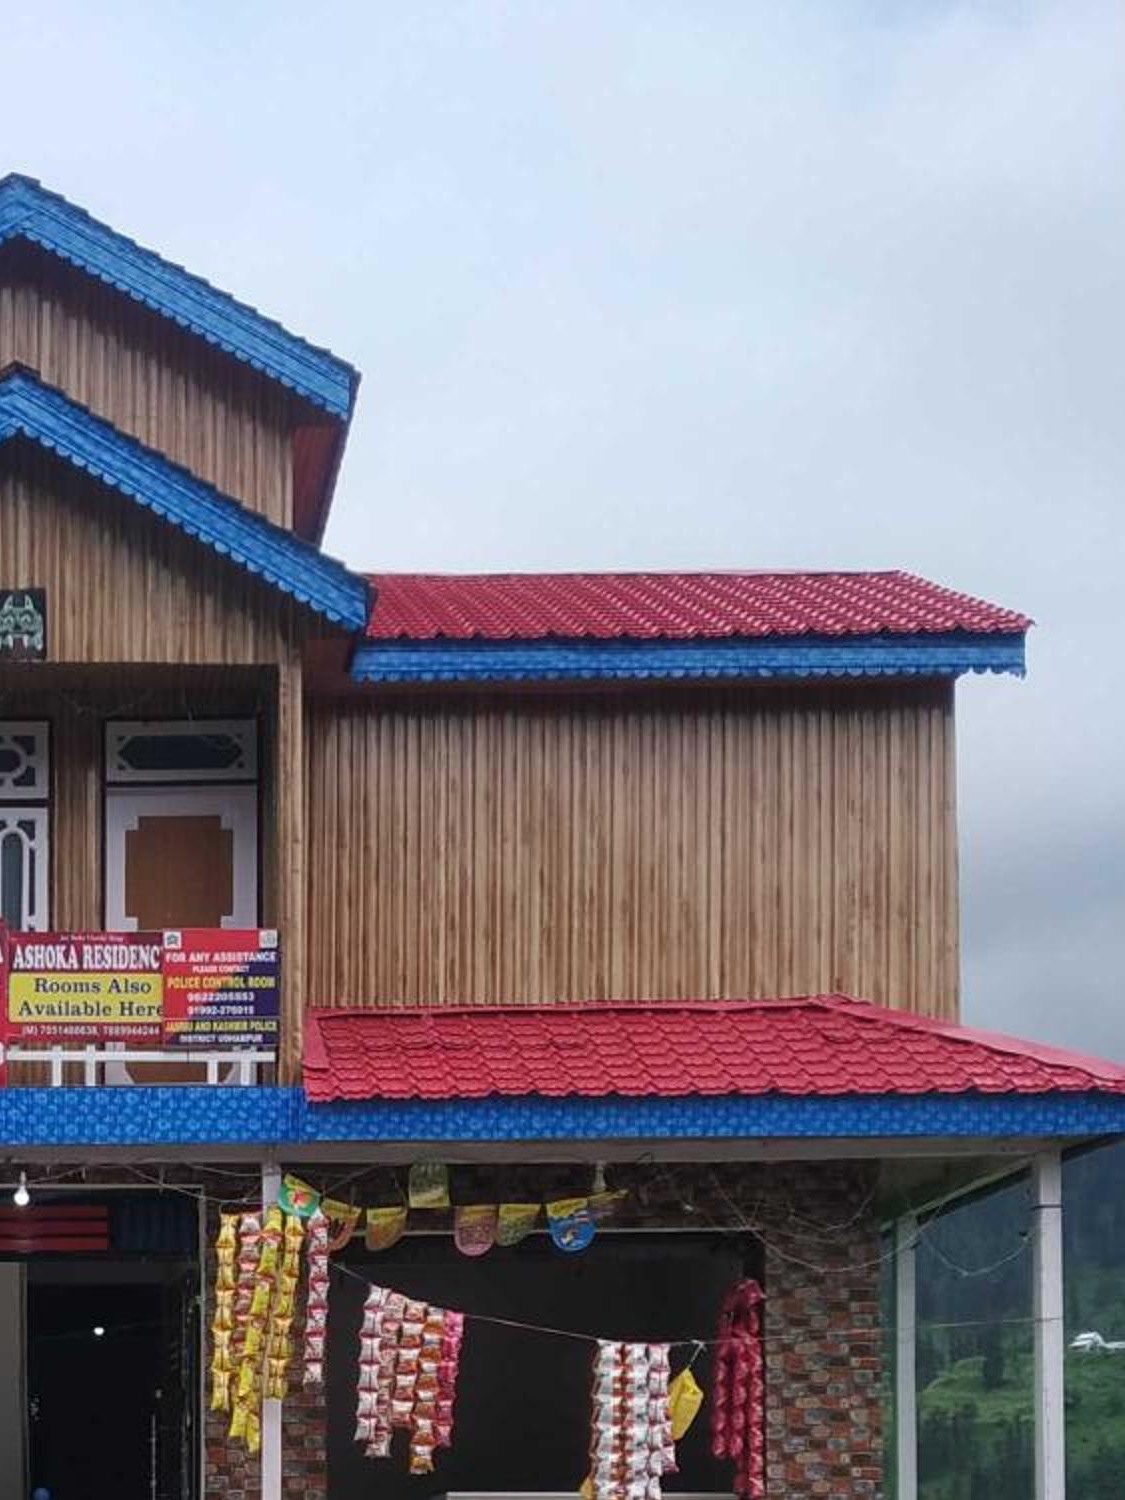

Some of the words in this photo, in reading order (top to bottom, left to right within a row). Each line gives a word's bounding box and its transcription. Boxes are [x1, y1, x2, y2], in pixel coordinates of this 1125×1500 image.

[12, 943, 79, 970] ASHOKA
[82, 943, 163, 970] RESIDENC
[165, 951, 187, 963] FOR
[189, 951, 211, 963] ANY
[213, 951, 277, 963] ASSISTANCE
[34, 977, 101, 993] Rooms
[107, 977, 152, 993] Also
[167, 976, 201, 988] POLICE
[202, 976, 247, 988] CONTROL
[248, 976, 276, 988] ROOM
[18, 1000, 112, 1017] Available
[119, 1000, 163, 1017] Here
[194, 1021, 212, 1032] AND
